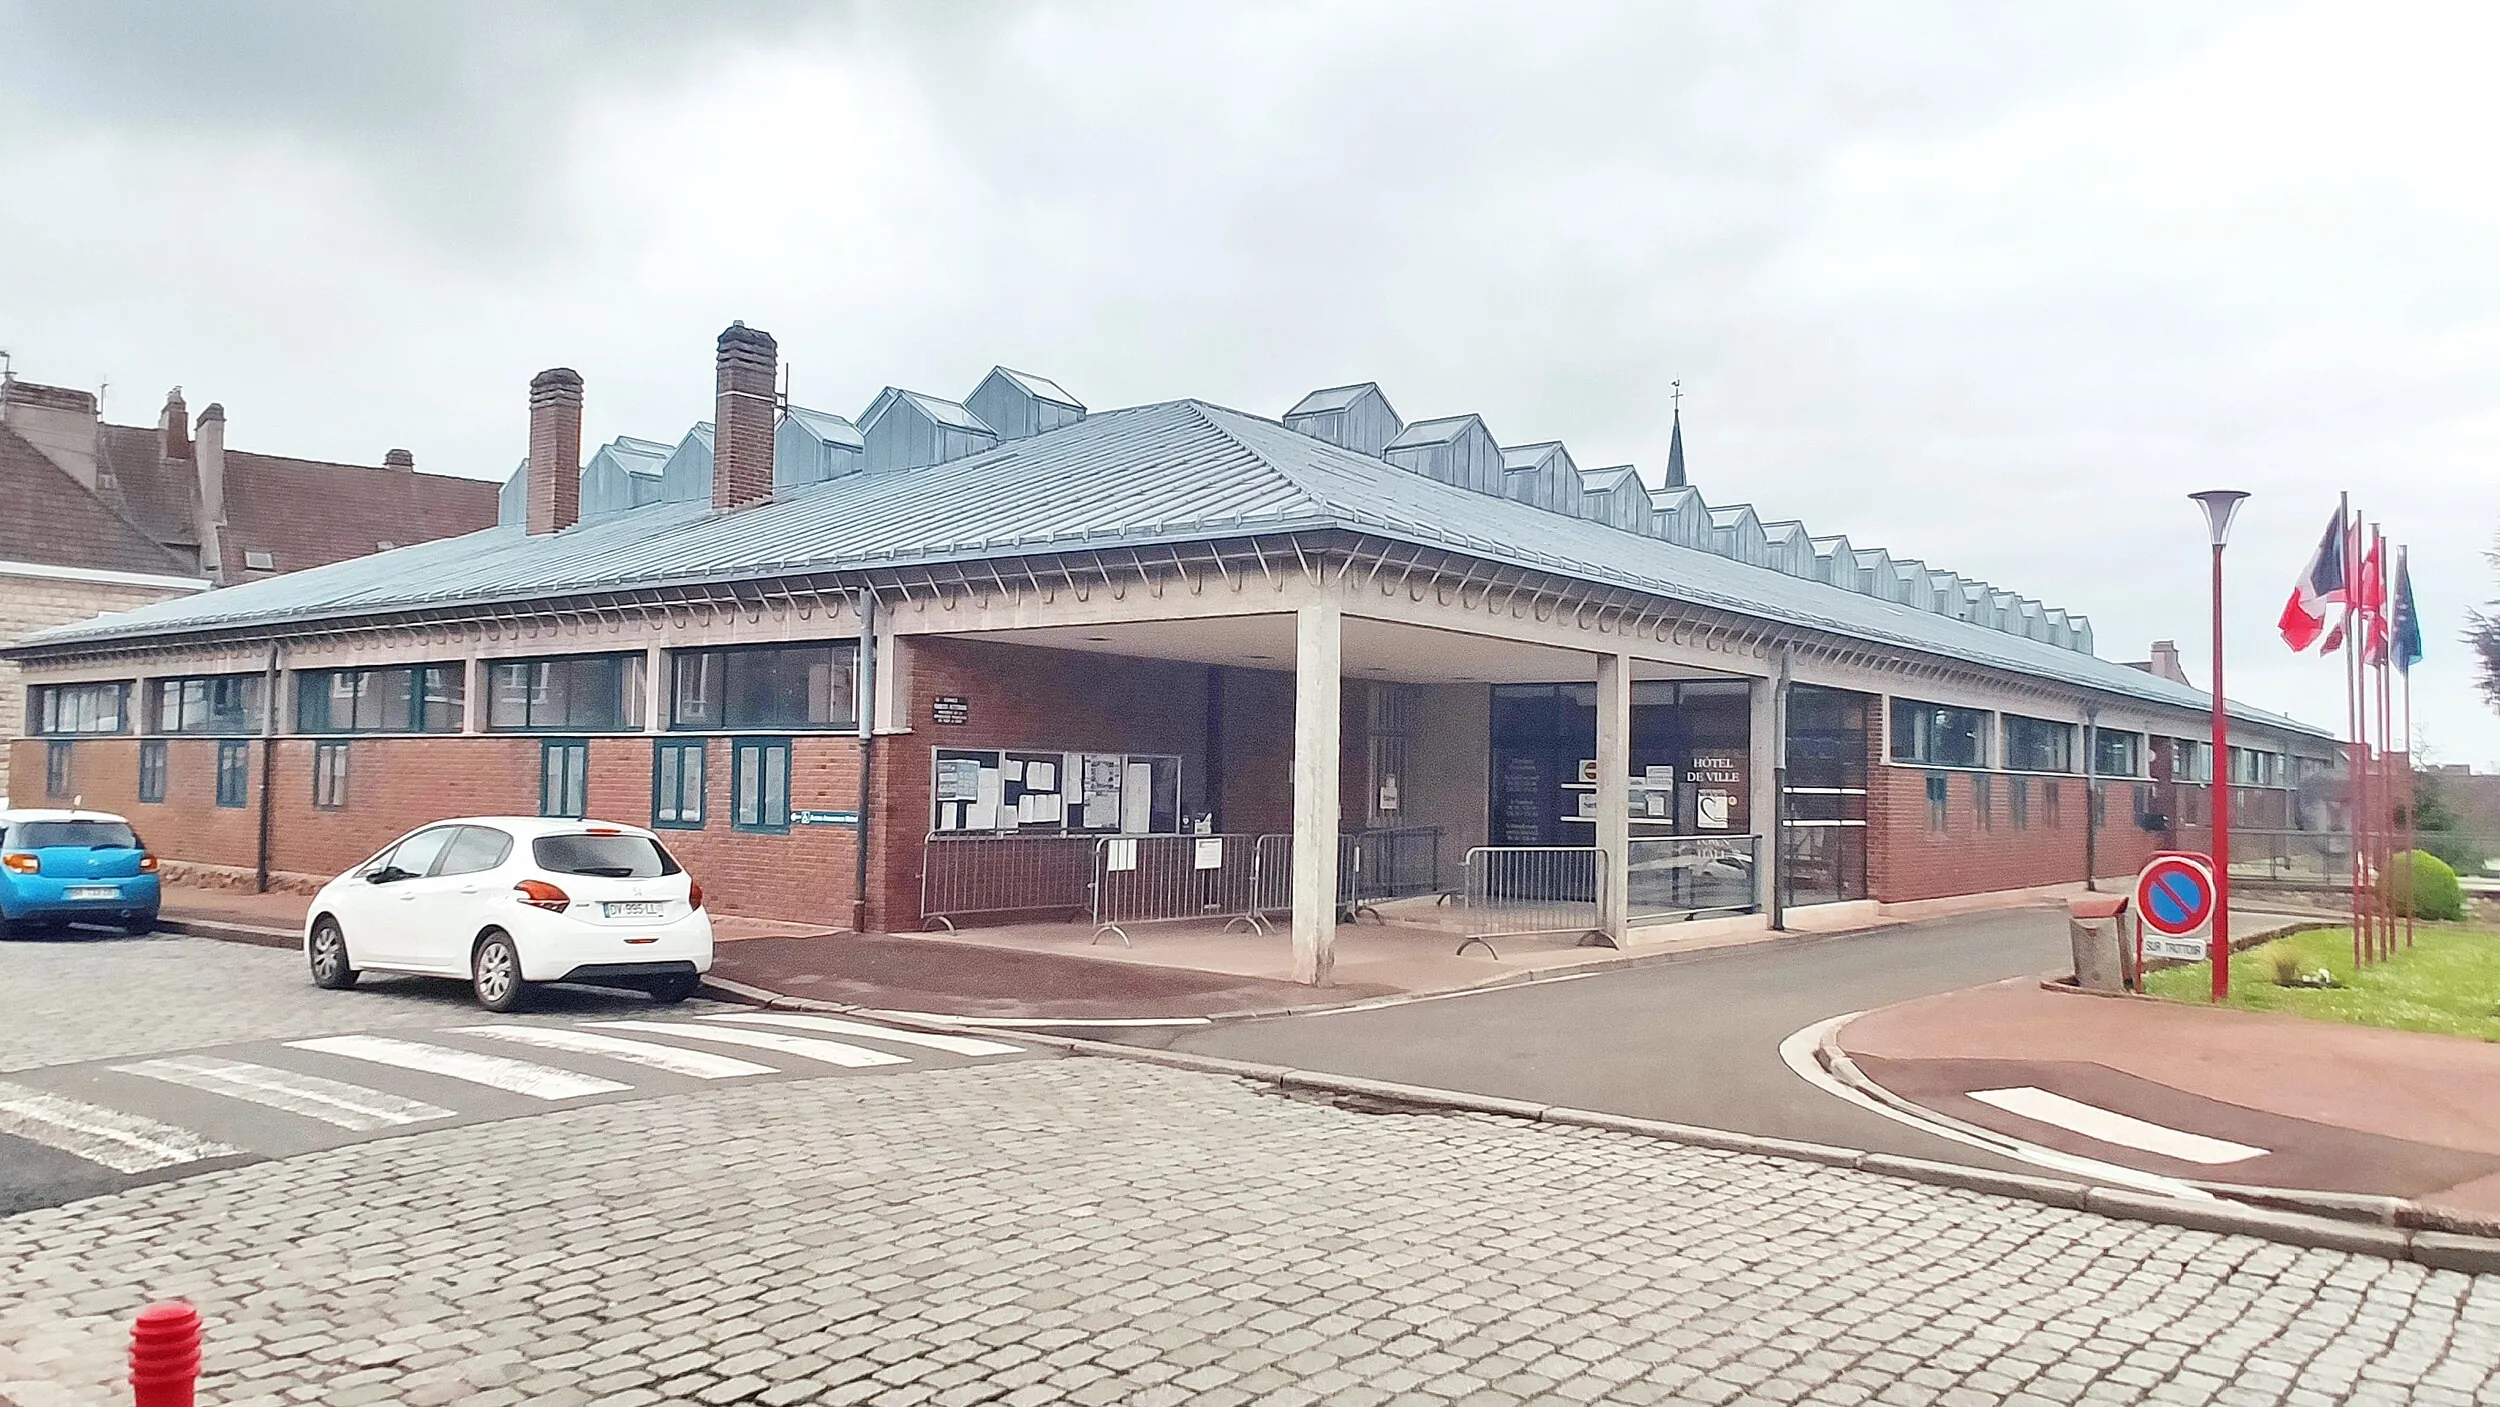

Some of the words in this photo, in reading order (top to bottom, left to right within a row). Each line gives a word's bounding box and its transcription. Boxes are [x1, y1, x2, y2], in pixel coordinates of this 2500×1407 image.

[1693, 756, 1734, 768] HÔTEL
[1686, 771, 1704, 782] DE
[1705, 771, 1741, 782] VILLE
[2146, 940, 2161, 952] SUR
[2165, 942, 2201, 955] TROTTOIR
